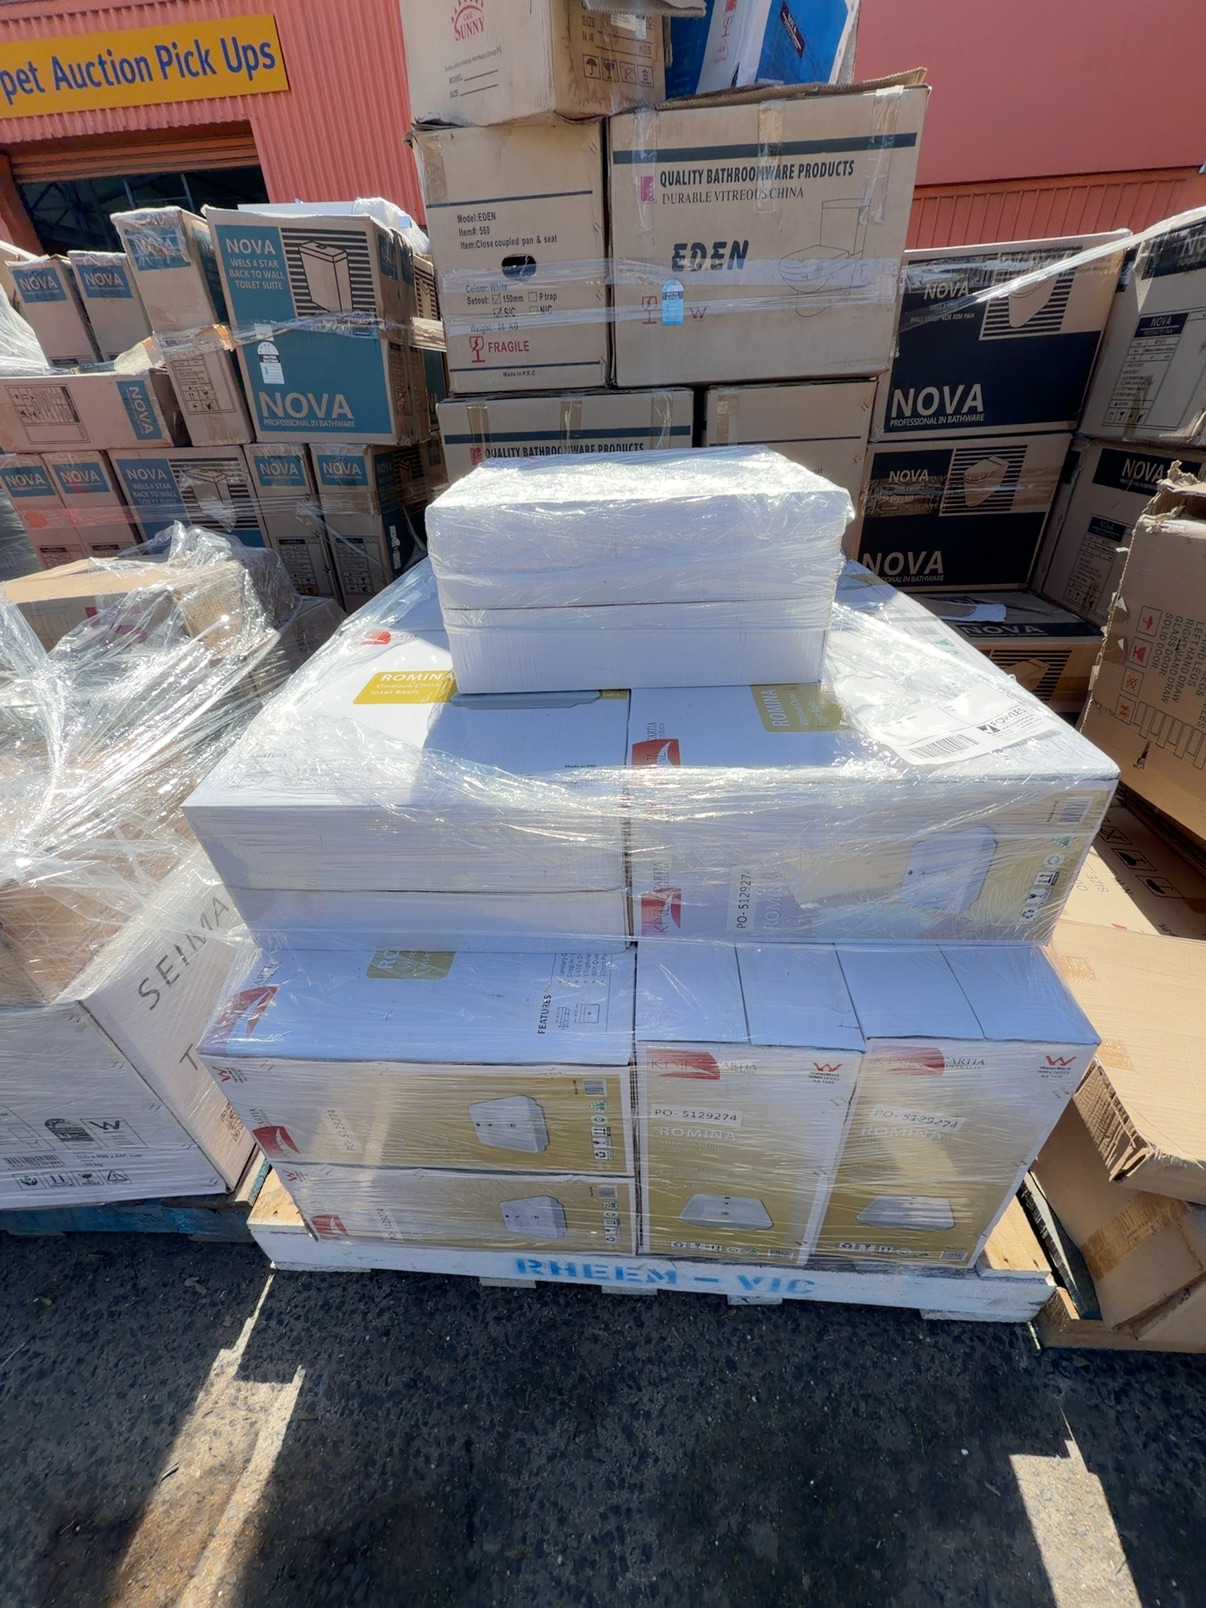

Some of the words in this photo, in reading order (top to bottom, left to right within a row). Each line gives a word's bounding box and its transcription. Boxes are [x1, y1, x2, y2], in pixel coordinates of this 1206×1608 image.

[455, 16, 484, 41] SUNNY
[0, 61, 45, 105] pet
[51, 48, 153, 91] Auction
[155, 39, 217, 80] Pick
[219, 36, 276, 82] Ups
[660, 168, 704, 188] QUALITY
[706, 164, 795, 184] BATHROOMWARE
[797, 160, 855, 179] PRODUCTS
[662, 190, 711, 205] DURABLE
[713, 187, 768, 202] VITREOUS
[769, 187, 804, 200] CHINA
[479, 225, 491, 236] 560
[225, 238, 276, 255] NOVA
[494, 237, 520, 247] coupled
[522, 236, 534, 246] pan
[536, 235, 541, 244] &
[543, 234, 558, 244] seat
[230, 259, 251, 267] WELS
[252, 259, 258, 267] 4
[258, 259, 279, 268] STAR
[671, 240, 749, 272] EDEN
[18, 275, 58, 291] NOVA
[83, 271, 125, 288] NOVA
[229, 269, 250, 278] BACK
[251, 269, 262, 279] TO
[262, 270, 285, 280] WALL
[234, 280, 261, 289] TOILET
[262, 281, 284, 290] SUITE
[924, 281, 970, 300] NOVA
[502, 294, 524, 303] 150mm
[544, 292, 558, 302] trap
[1150, 316, 1172, 327] NOVA
[488, 340, 530, 353] FRAGILE
[258, 391, 355, 419] NOVA
[890, 383, 984, 417] NOVA
[128, 386, 154, 434] NOVA
[264, 418, 311, 427] PROFESSIONAL
[311, 419, 319, 427] IN
[319, 420, 356, 428] BATHWARE
[890, 416, 937, 427] PROFESSIONAL
[937, 415, 947, 424] IN
[946, 413, 985, 424] BATHWARE
[485, 447, 520, 458] QUALITY
[522, 444, 596, 458] BATHROOMWARE
[597, 443, 644, 454] PRODUCTS
[60, 470, 101, 483] NOVA
[126, 468, 168, 481] NOVA
[260, 462, 300, 476] NOVA
[323, 461, 362, 475] NOVA
[889, 469, 929, 483] NOVA
[1121, 458, 1165, 483] NOVA
[5, 473, 46, 487] NOVA
[132, 482, 149, 490] WELS
[154, 482, 172, 490] STAR
[132, 490, 149, 498] BACK
[862, 550, 944, 576] NOVA
[962, 624, 1045, 635] NOVA
[1159, 612, 1174, 641] SOLID
[1168, 615, 1184, 648] GLASS
[1179, 618, 1194, 649] RIGHT
[1190, 621, 1204, 648] LEFT
[1149, 642, 1165, 672] DOOR:
[1157, 648, 1174, 679] DOOR:
[1180, 647, 1197, 676] HAND
[1187, 660, 1202, 688] LEGS
[1160, 676, 1176, 704] DRAW
[1172, 675, 1186, 704] DRAW
[760, 689, 791, 727] ROMINA
[990, 707, 1027, 726] FOWLES
[647, 721, 657, 741] CARTIA
[652, 861, 664, 892] CARTIA
[736, 911, 748, 929] PO-
[138, 896, 230, 1011] SEIMA
[418, 951, 432, 969] Inse
[537, 994, 552, 1034] FEATURES
[326, 1109, 351, 1138] 5129274
[654, 1108, 679, 1117] PO-
[682, 1110, 738, 1121] 5129274
[874, 1109, 899, 1118] PO-
[903, 1113, 958, 1129] 5129274
[660, 1127, 737, 1141] ROMINA
[861, 1126, 944, 1140] ROMINA
[376, 1208, 395, 1231] 5129274
[515, 1257, 677, 1285] RHEEM
[736, 1274, 816, 1295] VIC
